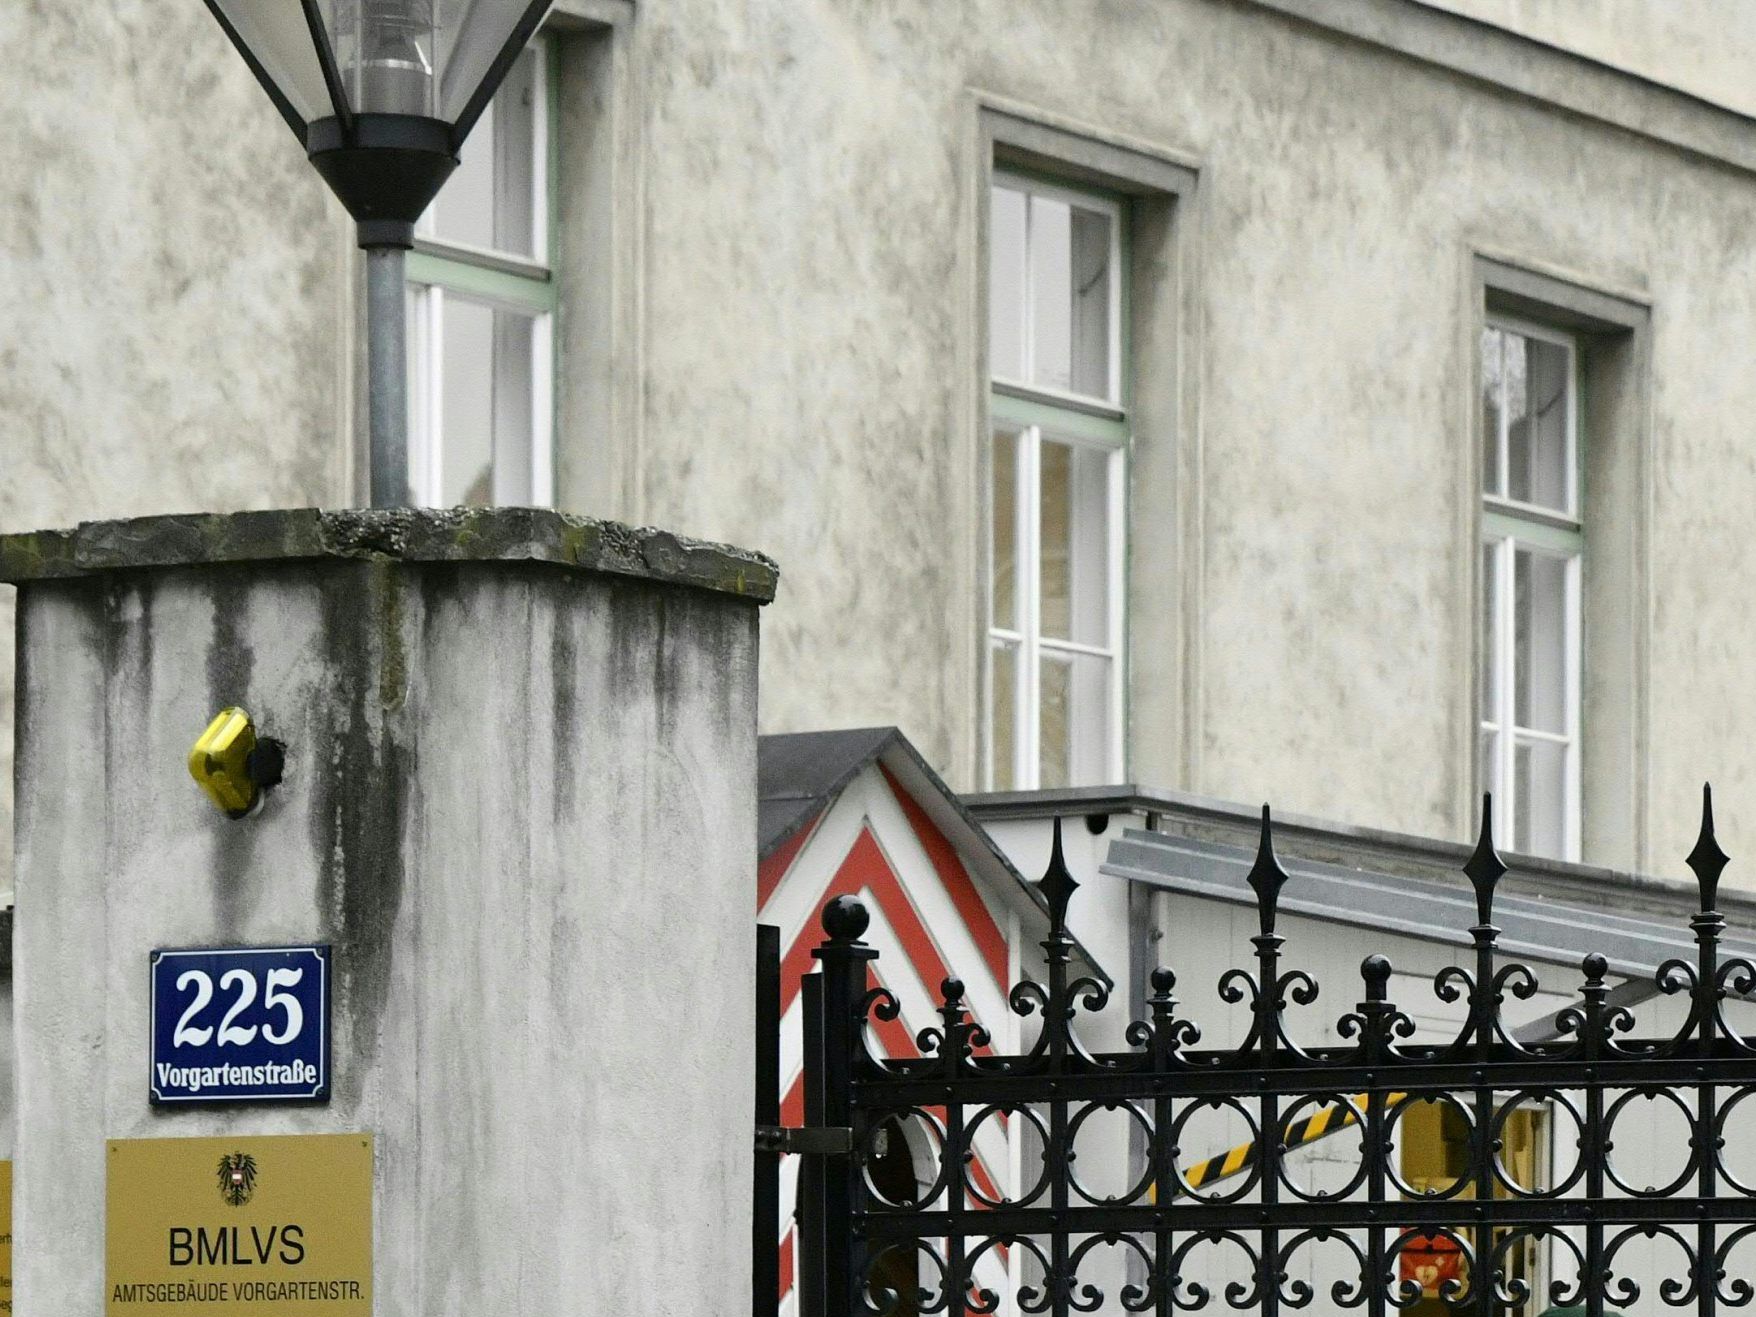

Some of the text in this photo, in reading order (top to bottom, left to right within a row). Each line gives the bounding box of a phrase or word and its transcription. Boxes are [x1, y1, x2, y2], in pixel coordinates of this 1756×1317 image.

[173, 967, 303, 1048] 225
[157, 1059, 316, 1092] Vorgartenstraße
[169, 1224, 305, 1266] BMLVS
[112, 1279, 365, 1303] AMTSGEBÄUDE VORGARTENSTR.
